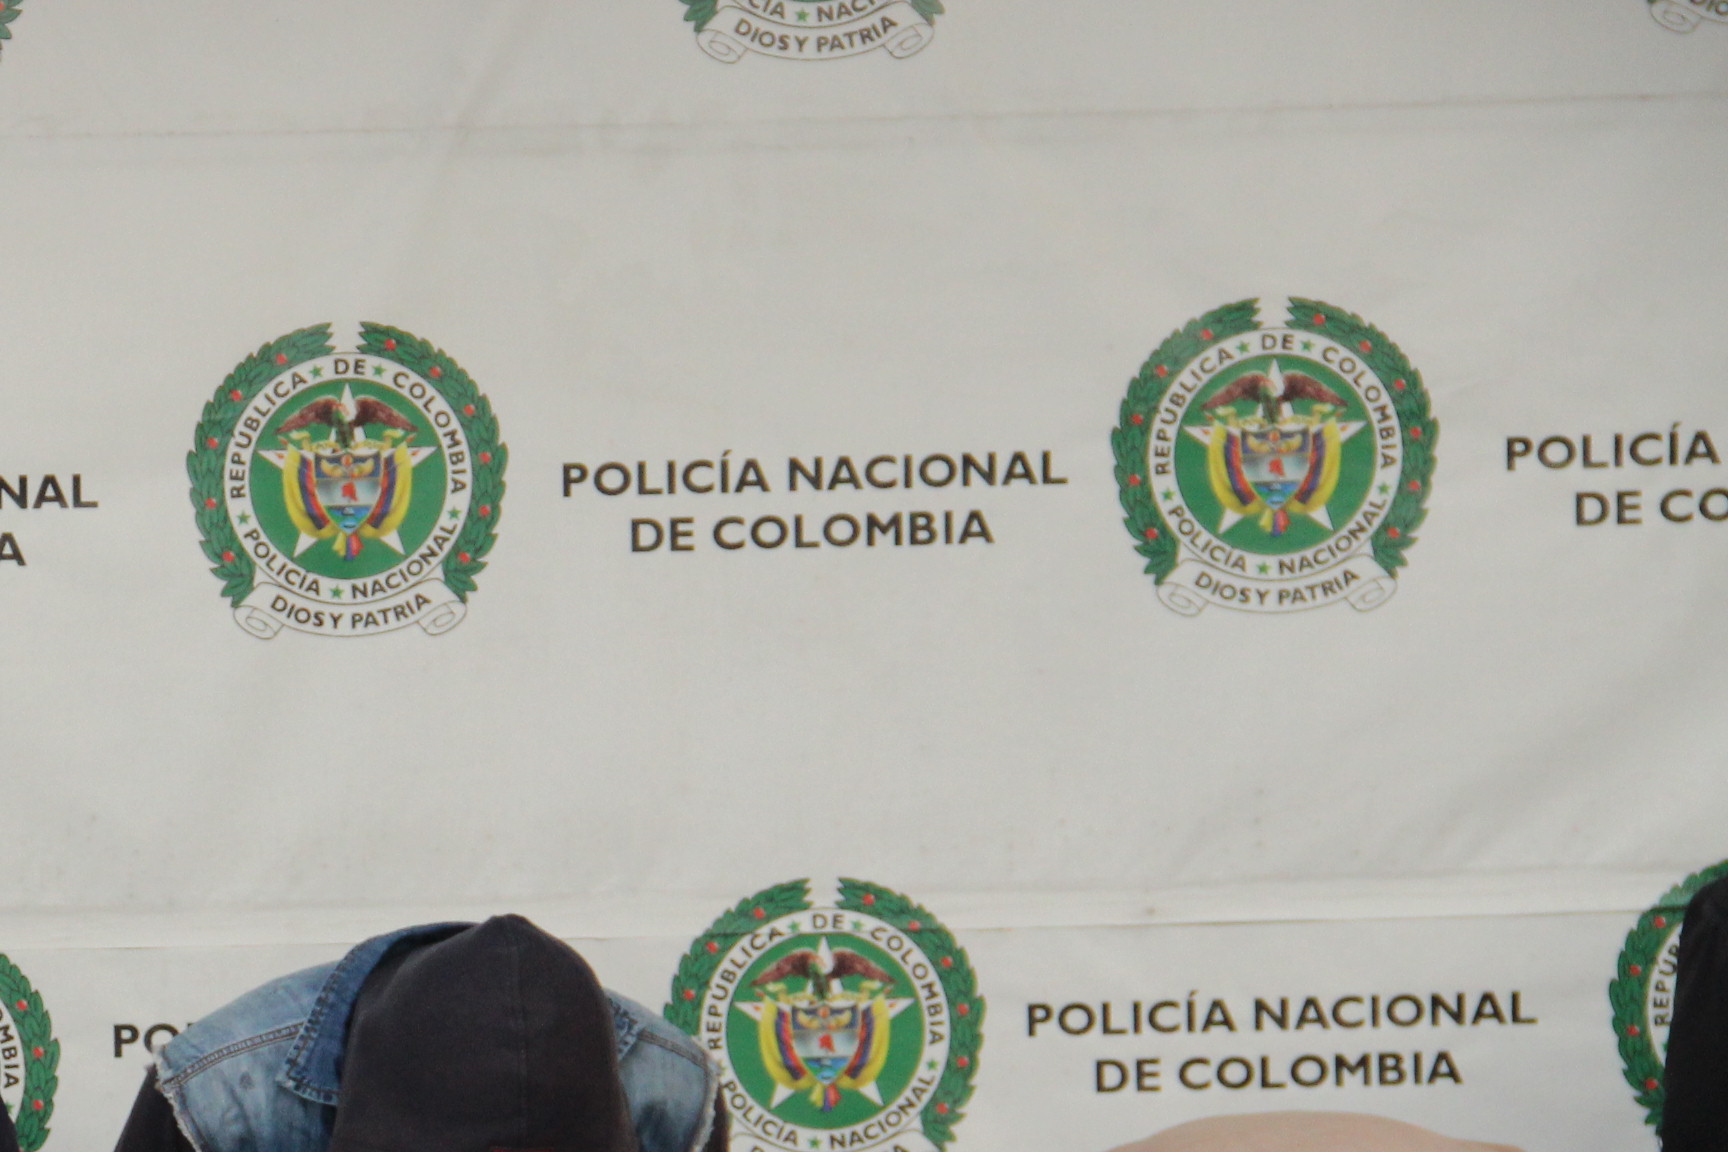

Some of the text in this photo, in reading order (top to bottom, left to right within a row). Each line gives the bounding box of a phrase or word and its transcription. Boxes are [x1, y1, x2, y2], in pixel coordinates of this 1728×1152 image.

[816, 16, 898, 52] PATRIA
[1261, 334, 1294, 350] DE
[1321, 346, 1397, 469] COLOMBIA
[334, 358, 366, 375] DE
[393, 371, 467, 494] COLOMBIA
[1506, 421, 1721, 471] POLICÍA
[562, 449, 1069, 497] POLICÍA NACIONAL
[630, 509, 995, 552] DE COLOMBIA
[1575, 490, 1642, 526] DE
[1278, 498, 1387, 574] NACIONAL
[351, 523, 457, 599] NACIONAL
[351, 593, 431, 629] PATRIA
[1278, 569, 1360, 605] PATRIA
[812, 914, 844, 930] DE
[870, 926, 944, 1045] COLOMBIA
[1027, 990, 1538, 1037] POLICÍA NACIONAL
[1095, 1051, 1463, 1093] DE COLOMBIA
[830, 1075, 935, 1150] NACIONAL
